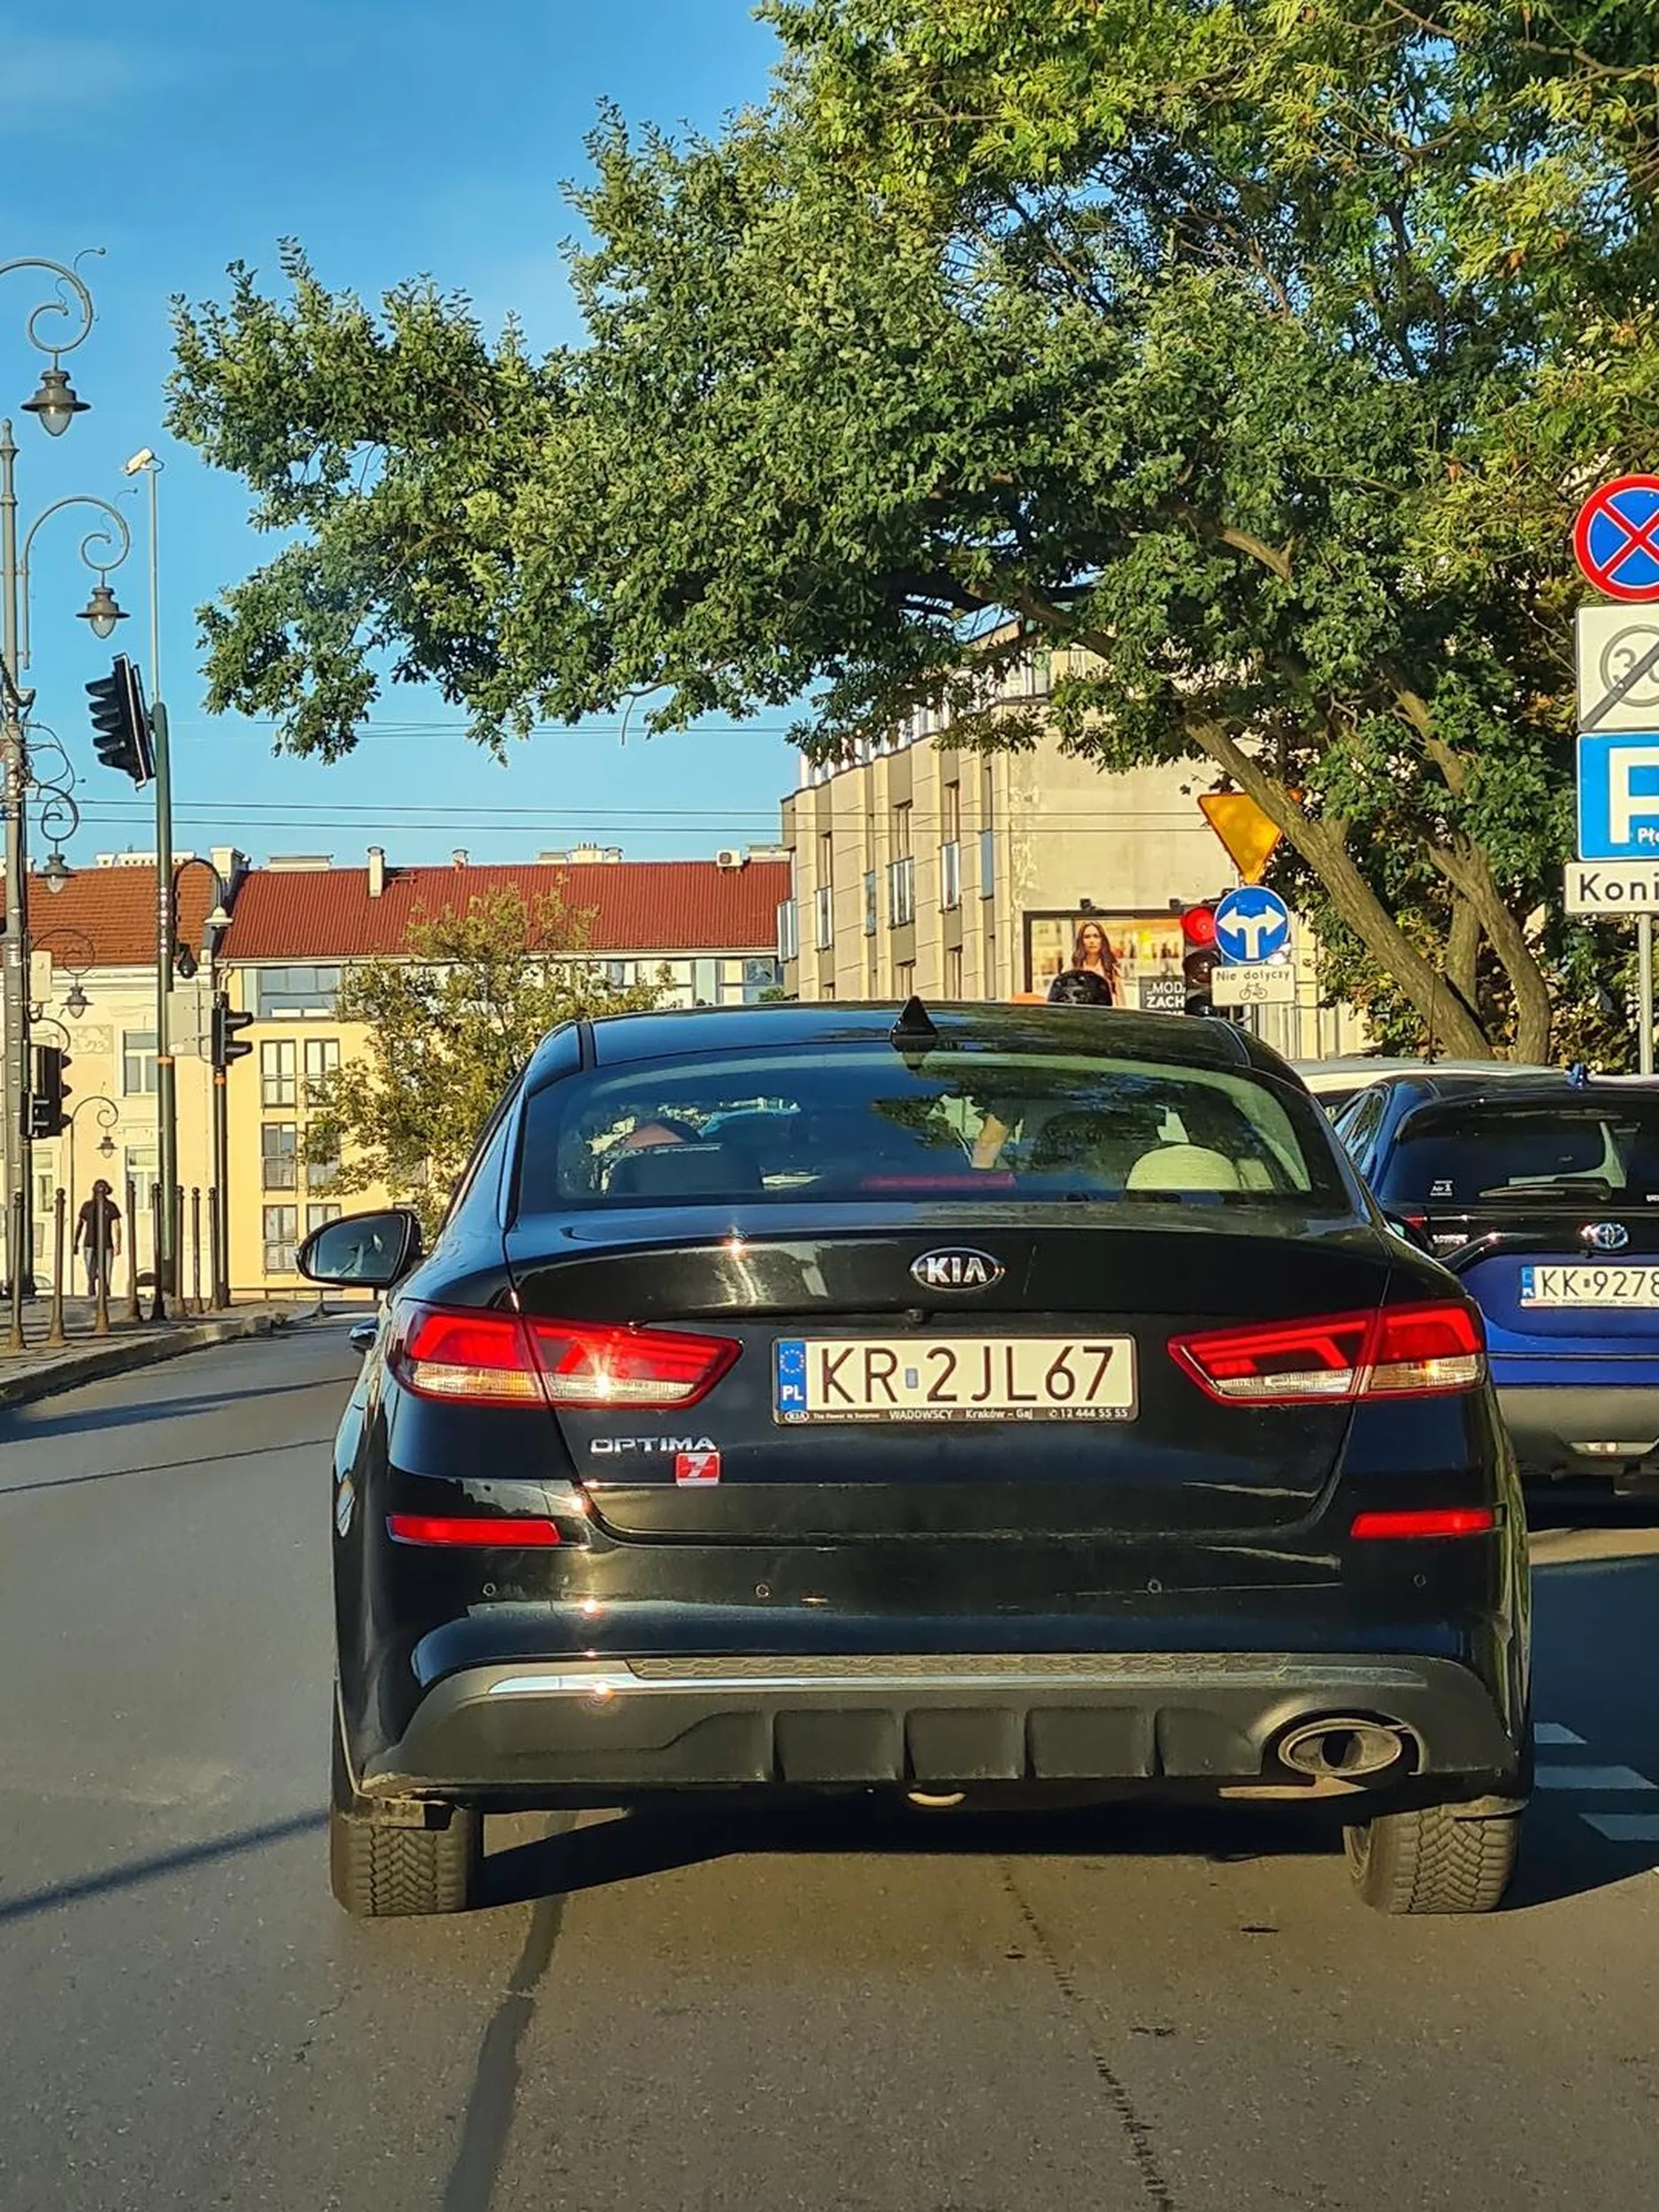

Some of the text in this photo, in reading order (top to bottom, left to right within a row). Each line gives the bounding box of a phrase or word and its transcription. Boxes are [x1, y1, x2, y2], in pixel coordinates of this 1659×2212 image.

[1216, 970, 1290, 982] Nie dotyczy
[926, 1256, 988, 1284] KIA
[1540, 1269, 1580, 1297] KK
[821, 1345, 1115, 1403] KR 2JL67
[782, 1384, 804, 1402] PL
[1060, 1408, 1073, 1418] 12
[590, 1436, 718, 1454] OPTIMA
